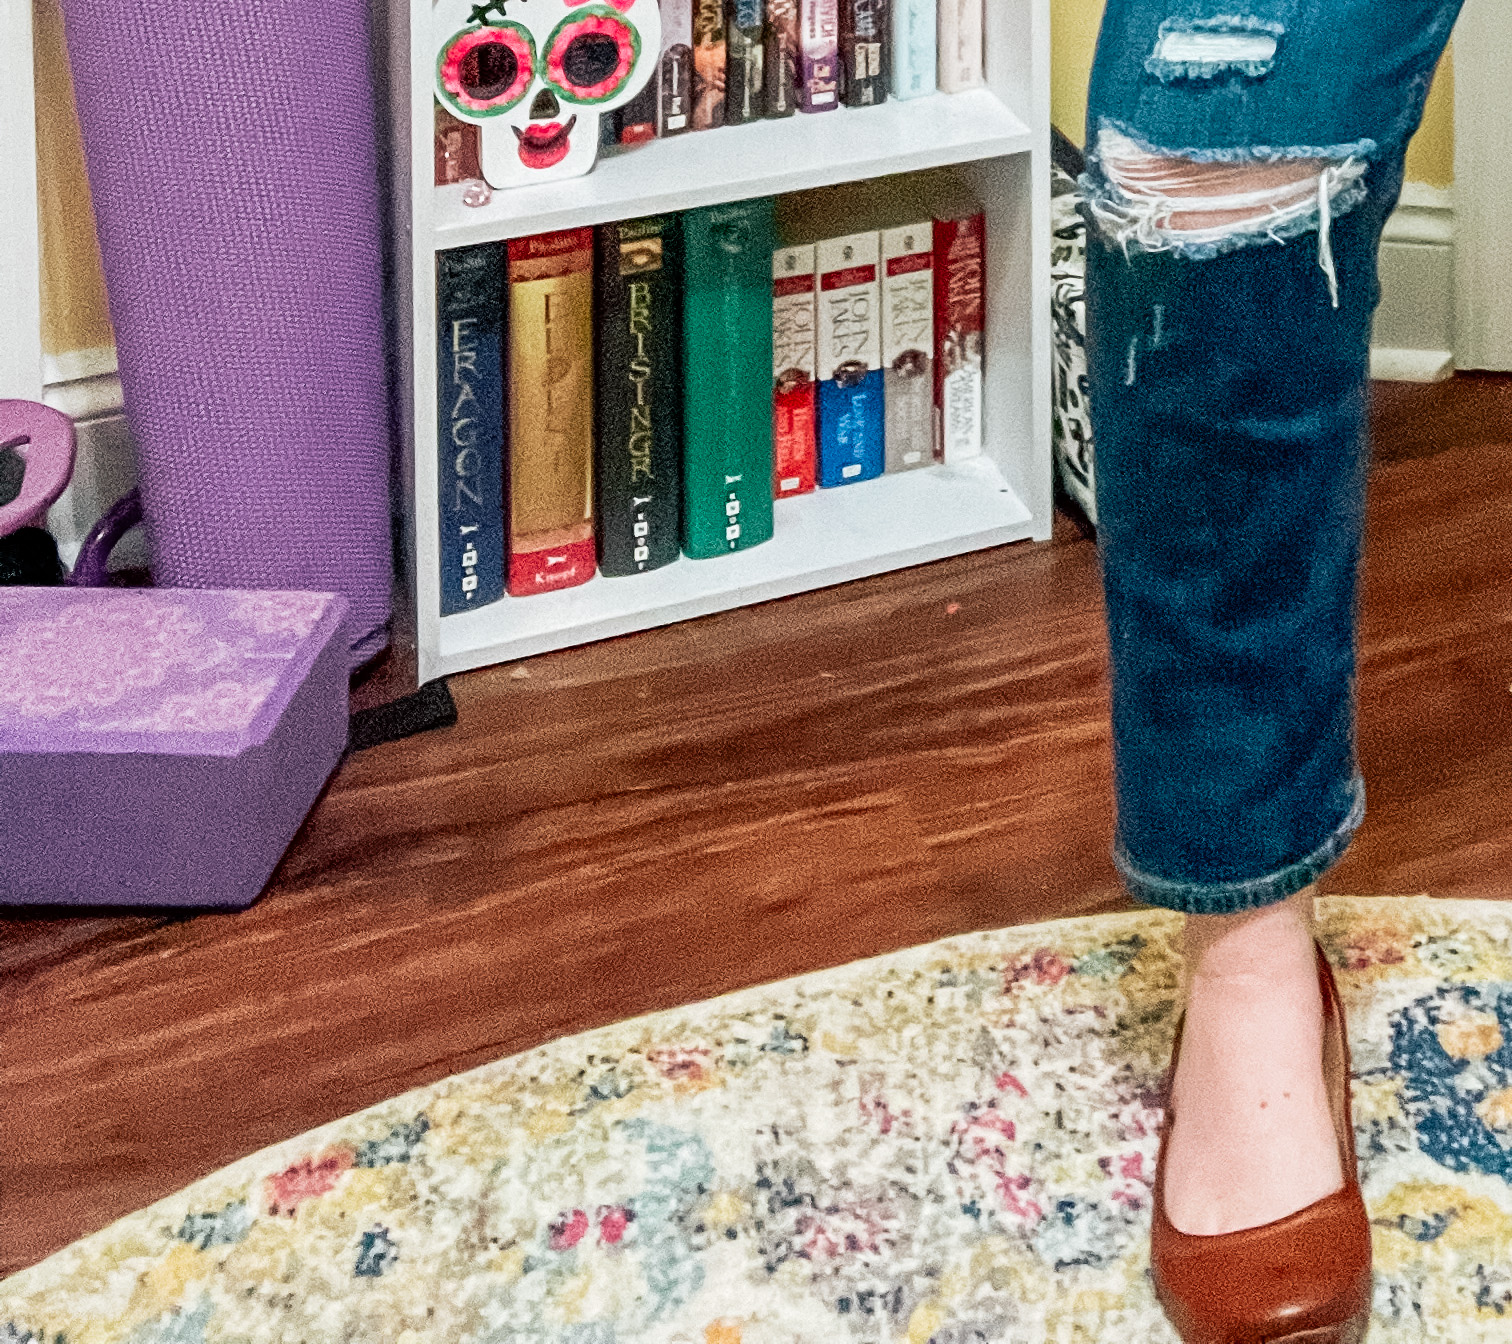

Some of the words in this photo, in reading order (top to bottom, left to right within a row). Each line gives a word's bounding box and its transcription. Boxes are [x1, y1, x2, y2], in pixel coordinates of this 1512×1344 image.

[774, 307, 793, 369] JAKES
[791, 300, 812, 365] JOHN
[829, 297, 852, 358] JAKES
[850, 290, 870, 355] JOHN
[889, 285, 912, 346] JAKES
[910, 278, 931, 340] JOHN
[628, 283, 654, 482] BRISINGR
[450, 318, 483, 511] ERAGON
